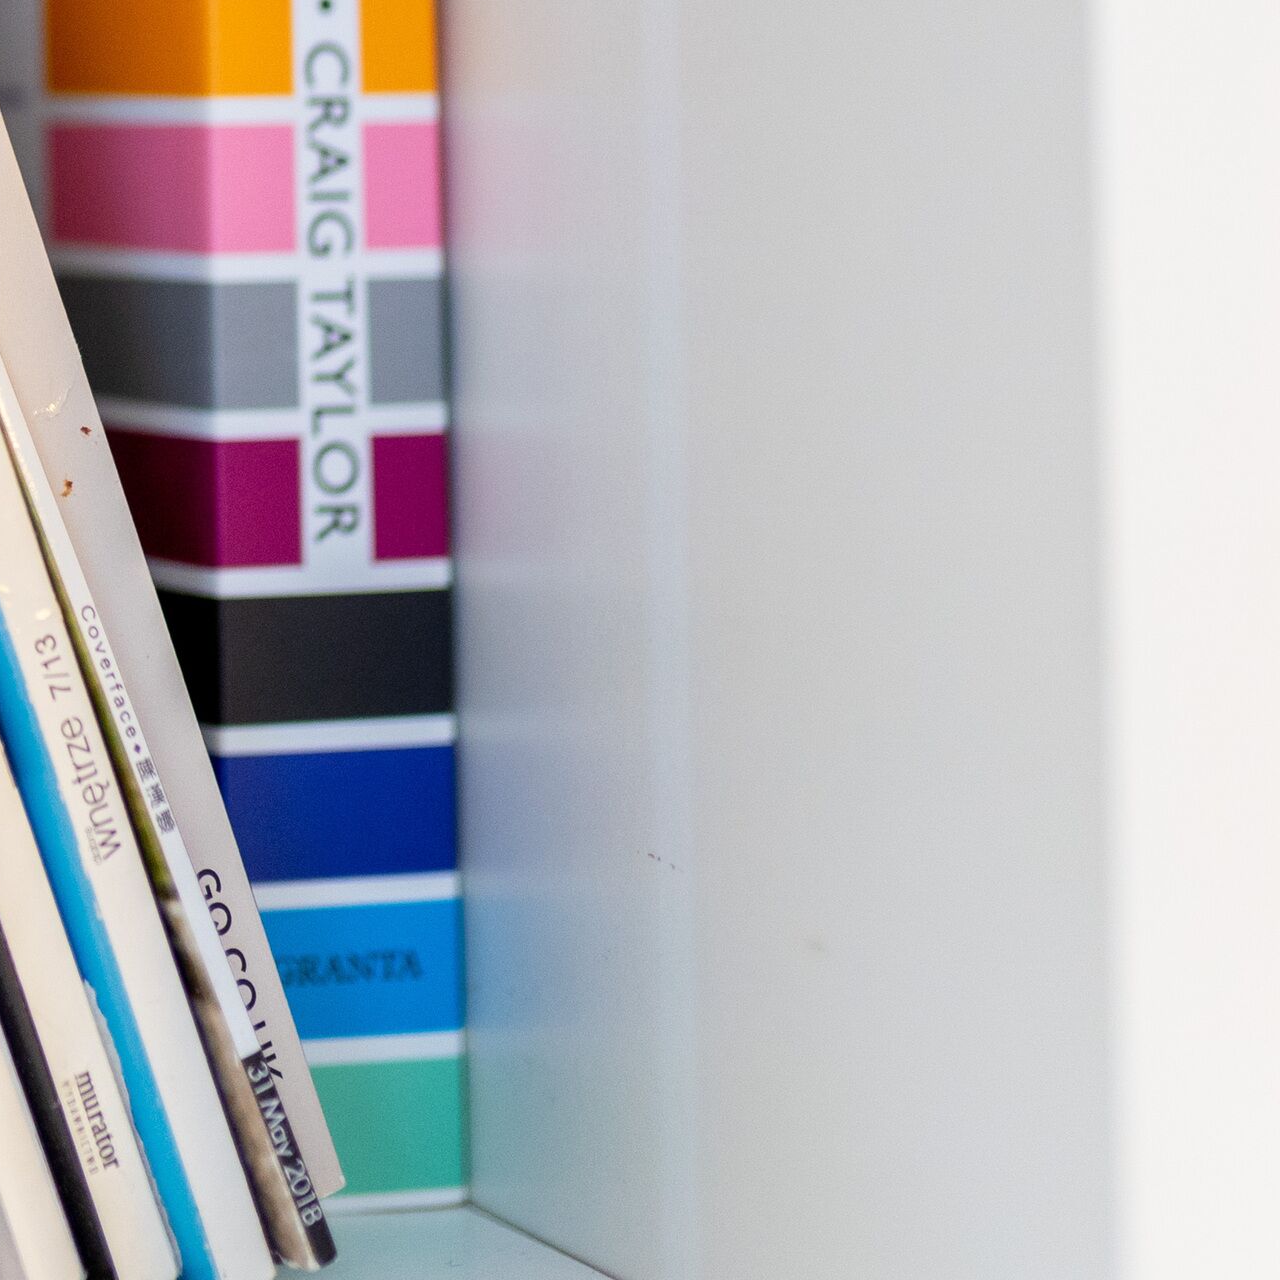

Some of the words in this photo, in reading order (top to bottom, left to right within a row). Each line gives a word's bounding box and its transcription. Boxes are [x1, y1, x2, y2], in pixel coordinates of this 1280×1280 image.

[303, 42, 355, 257] CRAIG
[309, 276, 361, 543] TAYLOR
[81, 604, 135, 738] Coverface
[74, 1070, 120, 1169] murator
[248, 1058, 274, 1094] 31
[263, 1100, 294, 1160] May
[282, 1155, 323, 1227] 2018
